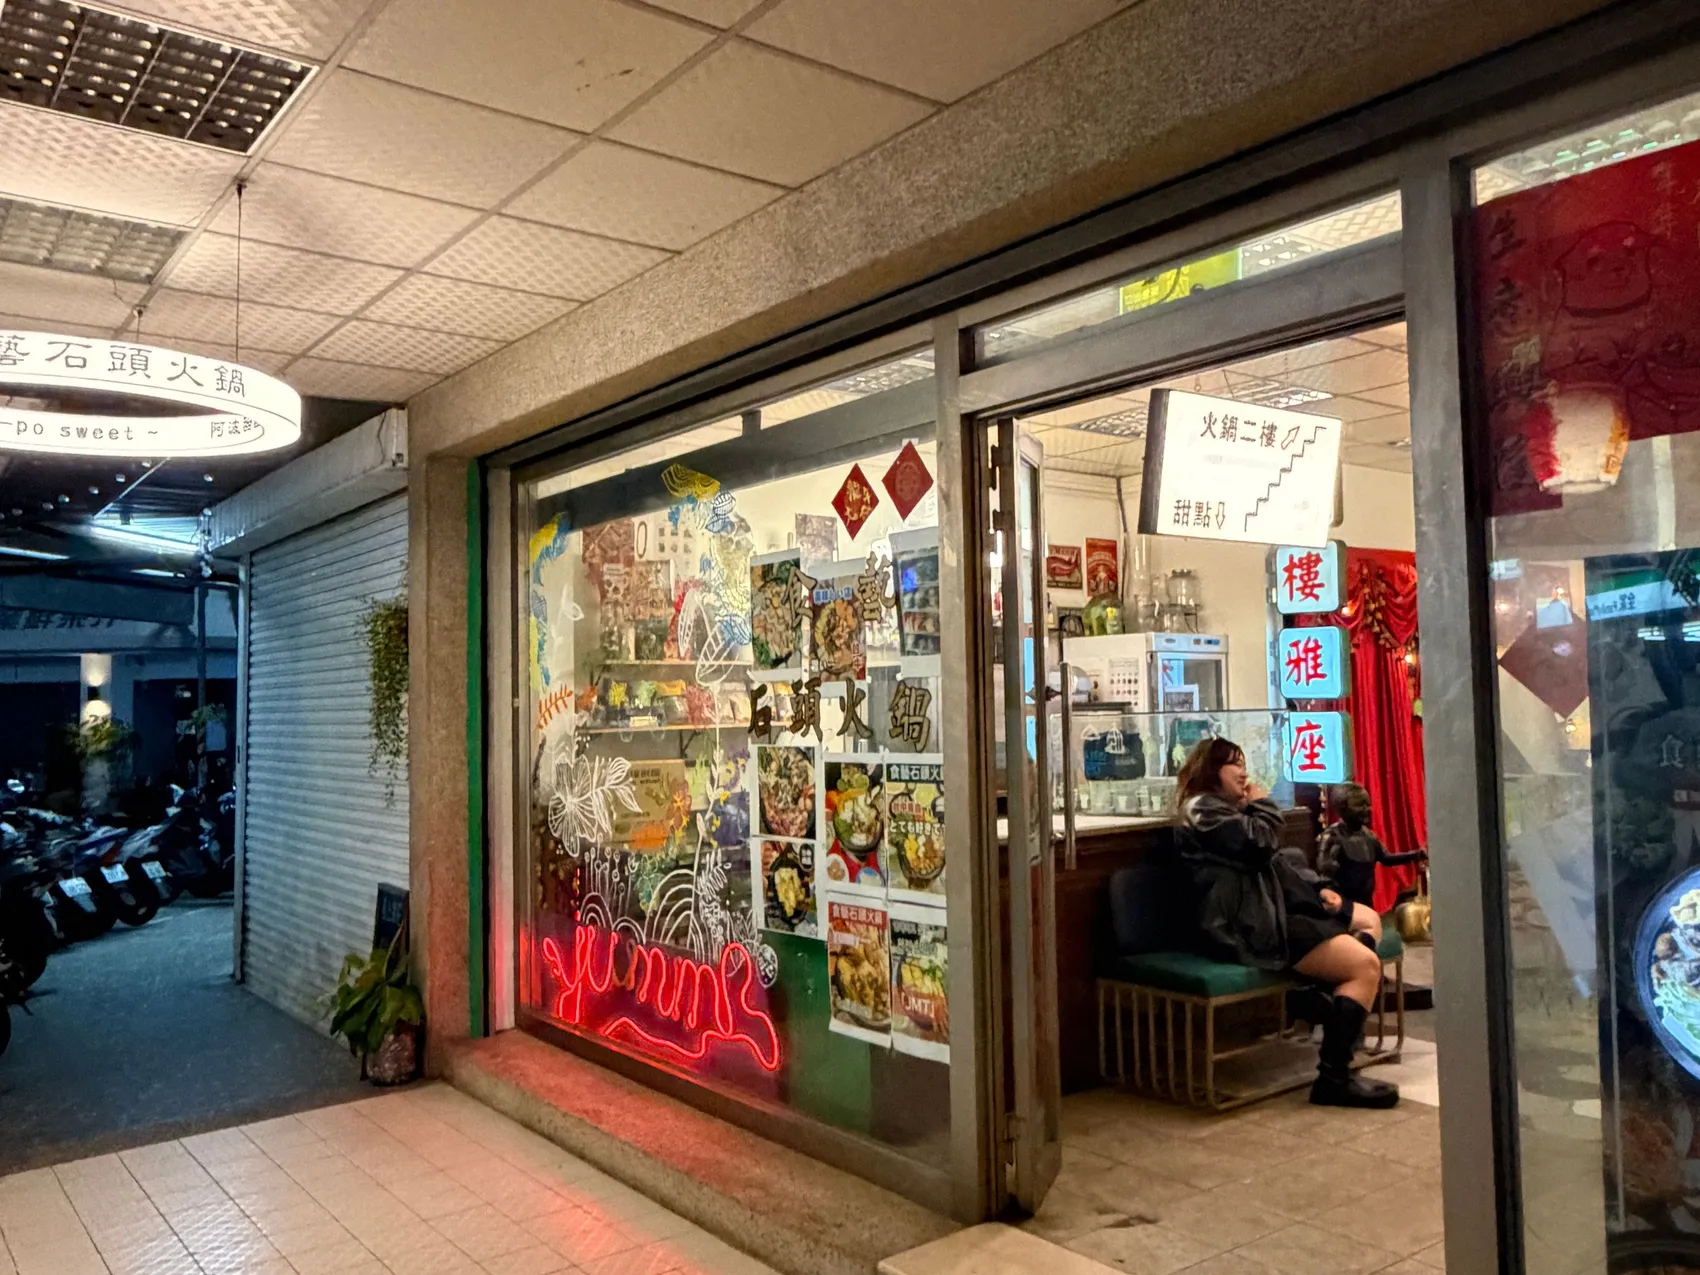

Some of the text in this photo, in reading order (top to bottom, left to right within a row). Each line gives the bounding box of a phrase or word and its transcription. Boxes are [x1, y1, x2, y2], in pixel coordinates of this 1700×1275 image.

[60, 425, 133, 441] sweet
[1200, 411, 1278, 448] 火鍋二樓
[1173, 499, 1212, 528] 甜點
